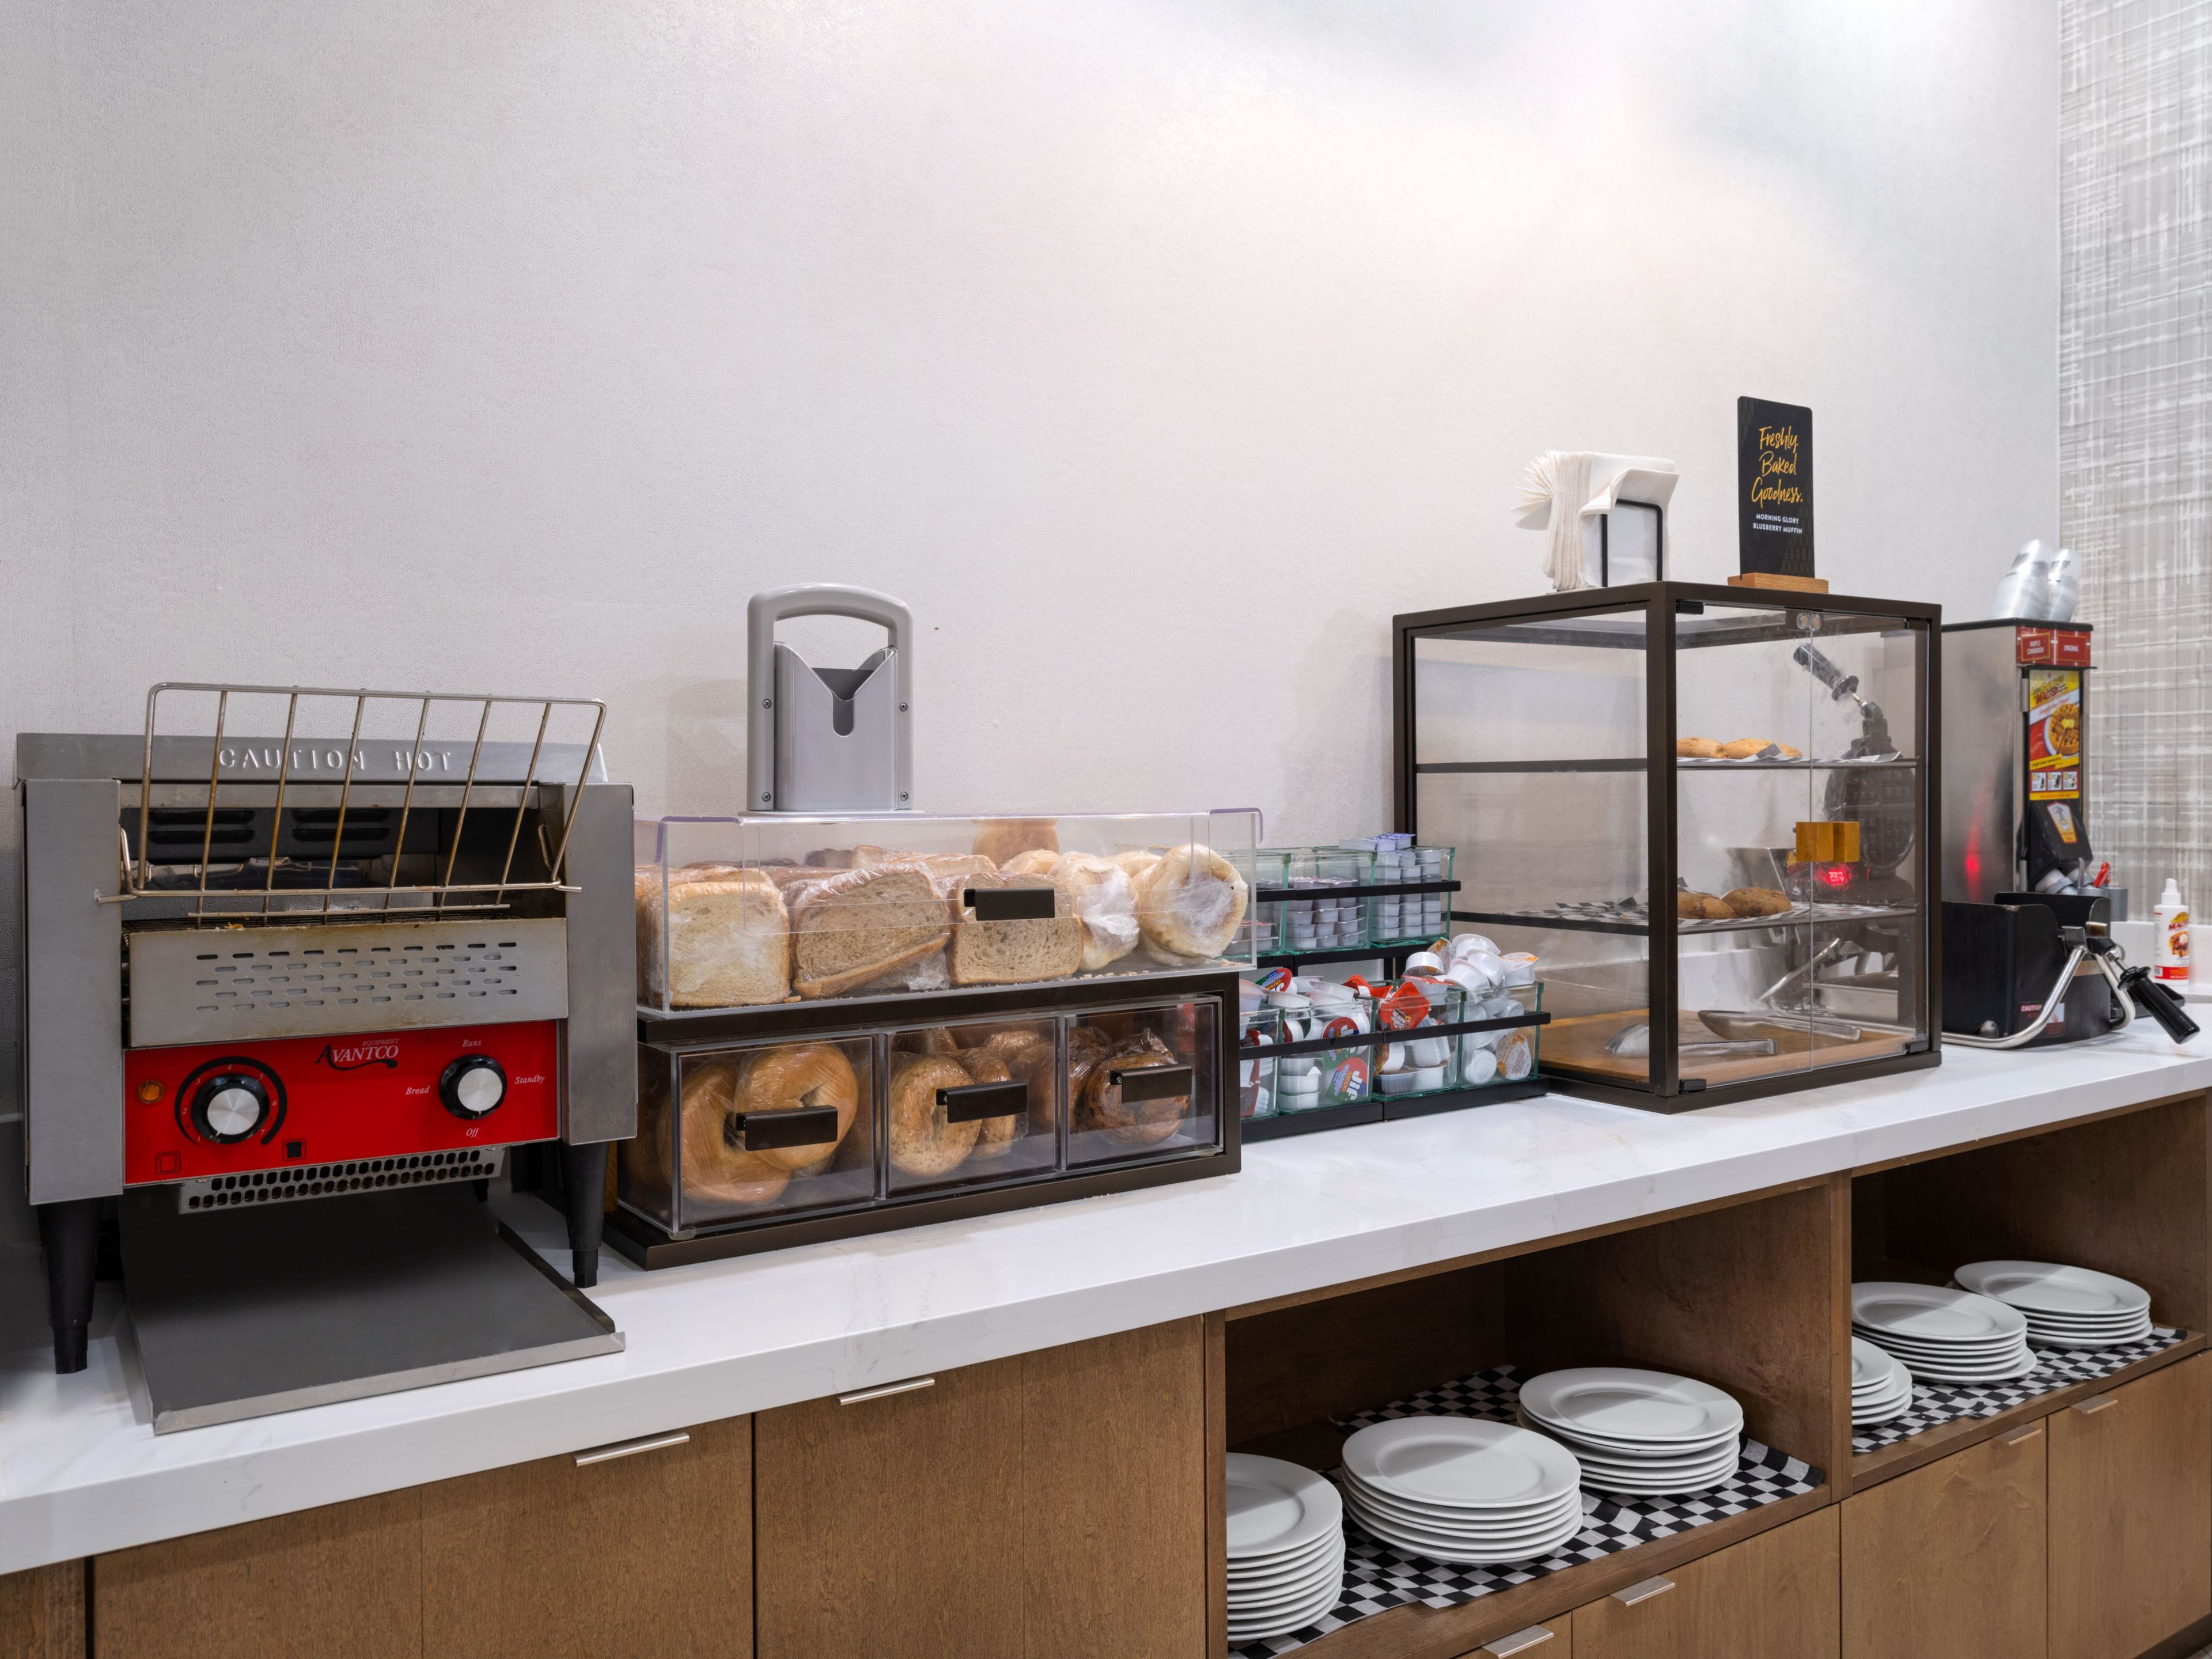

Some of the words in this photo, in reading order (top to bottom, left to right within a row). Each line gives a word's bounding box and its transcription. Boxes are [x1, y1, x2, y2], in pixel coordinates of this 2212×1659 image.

[1759, 426, 1799, 453] Freshly
[1759, 450, 1797, 476] Baked
[1752, 476, 1803, 509] Goodness.
[1756, 513, 1781, 522] MORNING
[1753, 522, 1782, 532] BLUEBERRY
[1783, 526, 1802, 534] MUFFIN
[219, 748, 365, 770] CAUTION
[394, 751, 450, 771] HOT
[362, 1038, 399, 1047] EQUIPMENT
[462, 1039, 482, 1047] Buns
[315, 1043, 399, 1067] AVANTCO
[514, 1074, 545, 1084] Standby
[406, 1086, 430, 1095] Bread
[1346, 1070, 1363, 1101] Jif
[466, 1128, 479, 1138] Off
